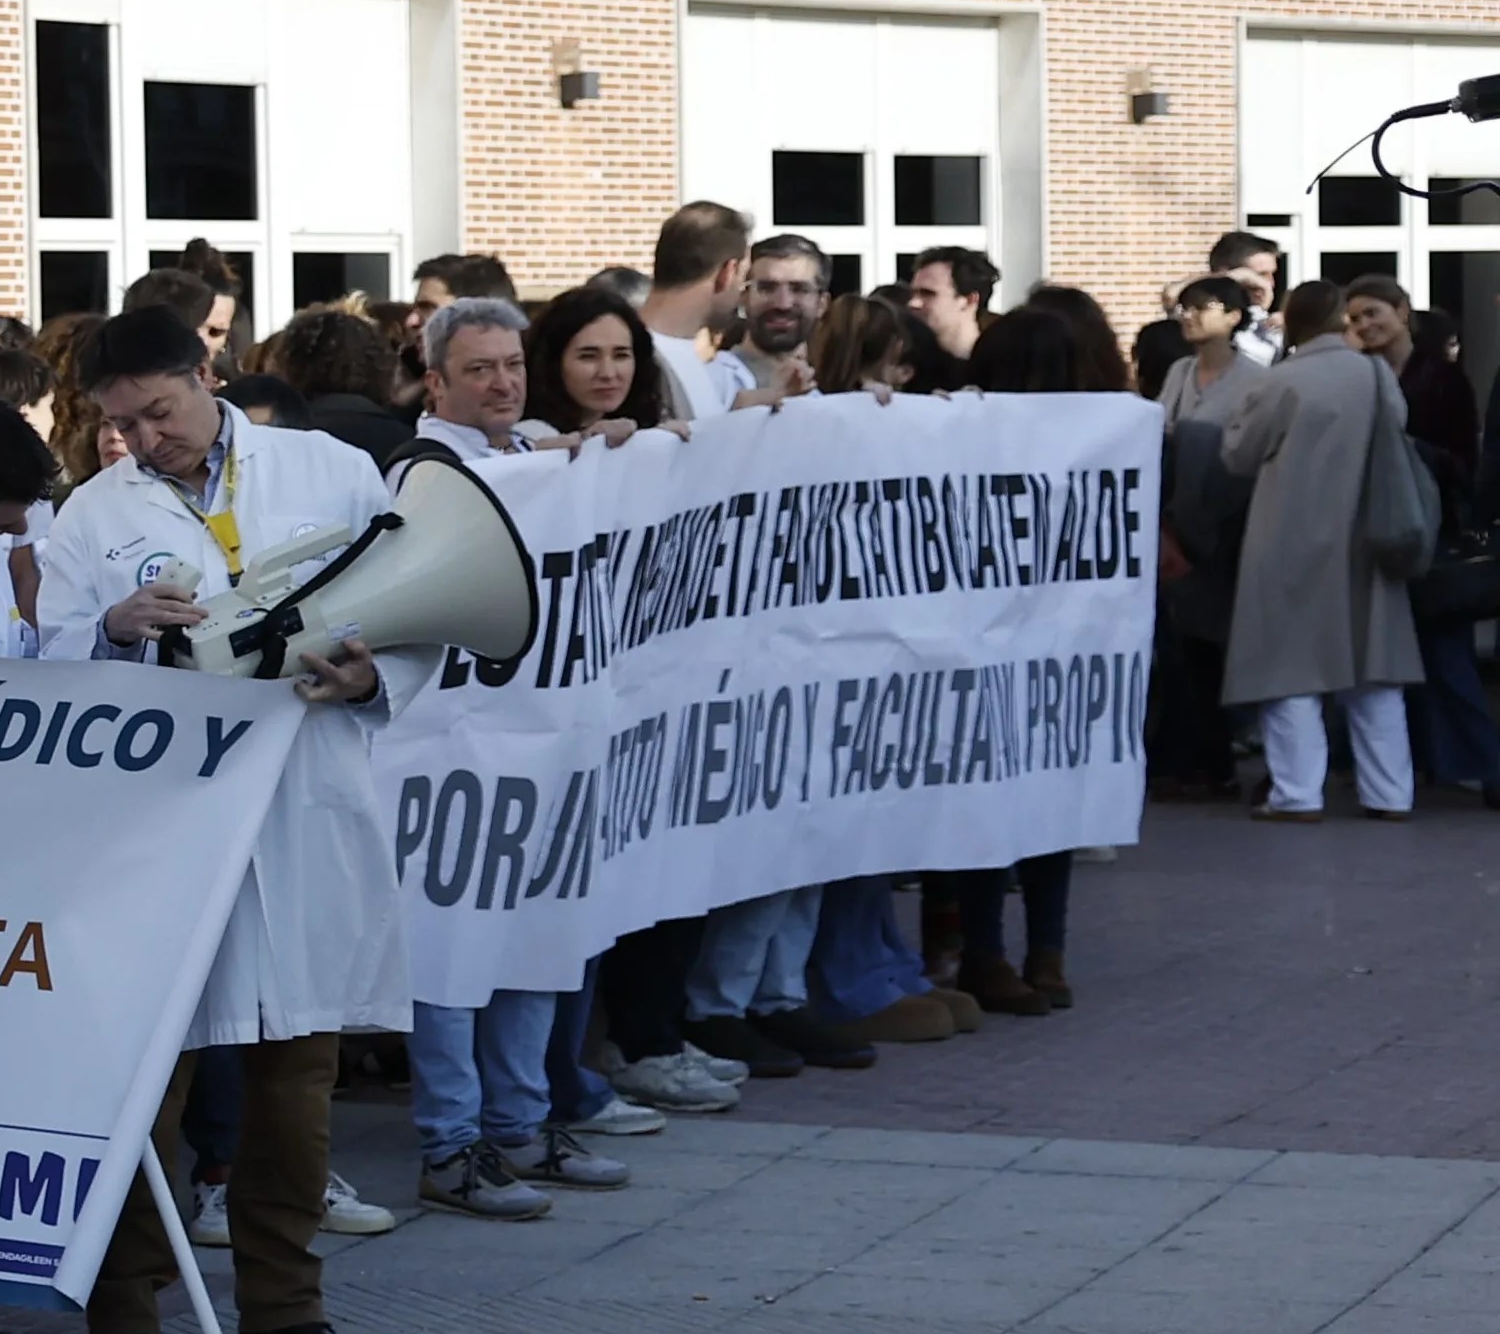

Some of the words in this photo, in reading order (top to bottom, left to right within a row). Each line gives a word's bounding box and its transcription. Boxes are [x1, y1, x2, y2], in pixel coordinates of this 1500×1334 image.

[1050, 468, 1142, 583] ALDE
[198, 715, 254, 778] Y
[395, 768, 538, 910] POR
